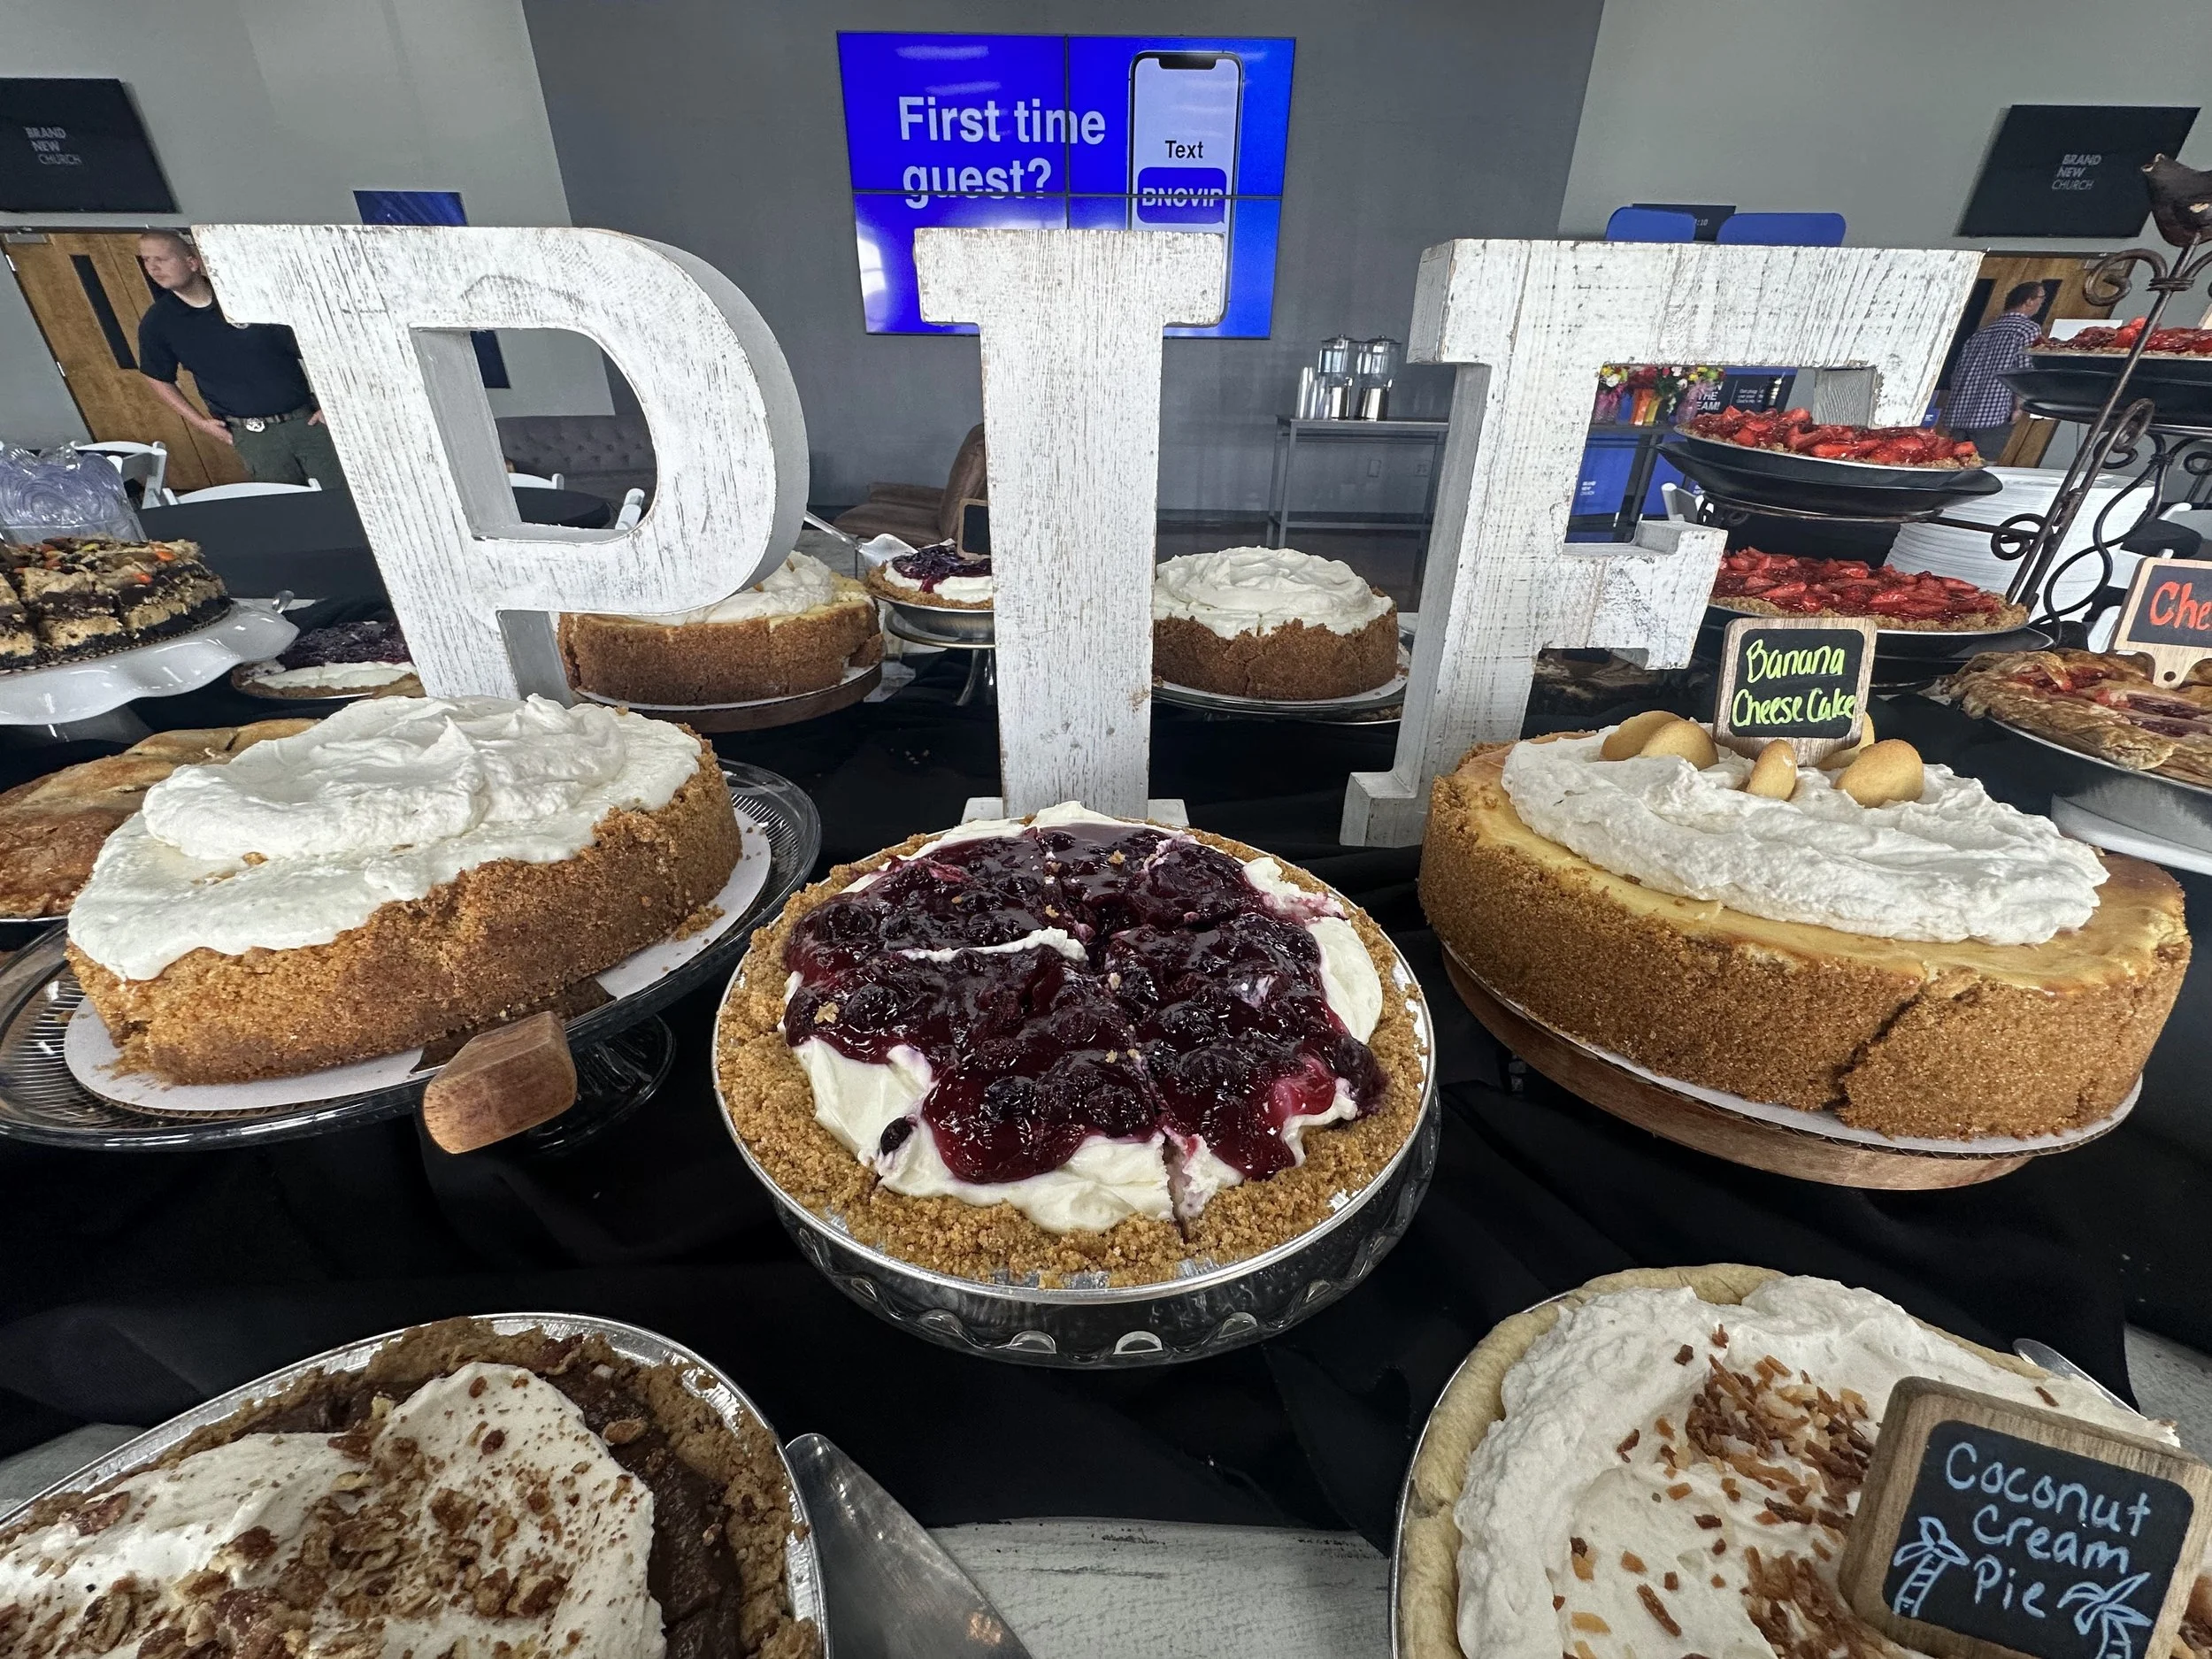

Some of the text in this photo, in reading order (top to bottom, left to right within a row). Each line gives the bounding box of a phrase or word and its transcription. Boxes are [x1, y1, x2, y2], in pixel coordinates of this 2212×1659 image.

[898, 96, 1106, 145] First time
[24, 127, 67, 139] BRAND
[31, 140, 60, 152] NEW
[1164, 140, 1203, 159] Text
[38, 153, 83, 165] CHURCH
[2062, 154, 2102, 165] BRAND
[2056, 165, 2086, 178] NEW
[902, 157, 1052, 209] guest?
[2051, 179, 2094, 190] CHURCH
[1696, 401, 1721, 411] EAM!
[1746, 638, 1846, 684] Banana
[1732, 687, 1857, 727] Cheese Cake
[1946, 1441, 2151, 1538] Coconut
[1972, 1503, 2130, 1574] Cream
[1973, 1554, 2047, 1617] Pie
